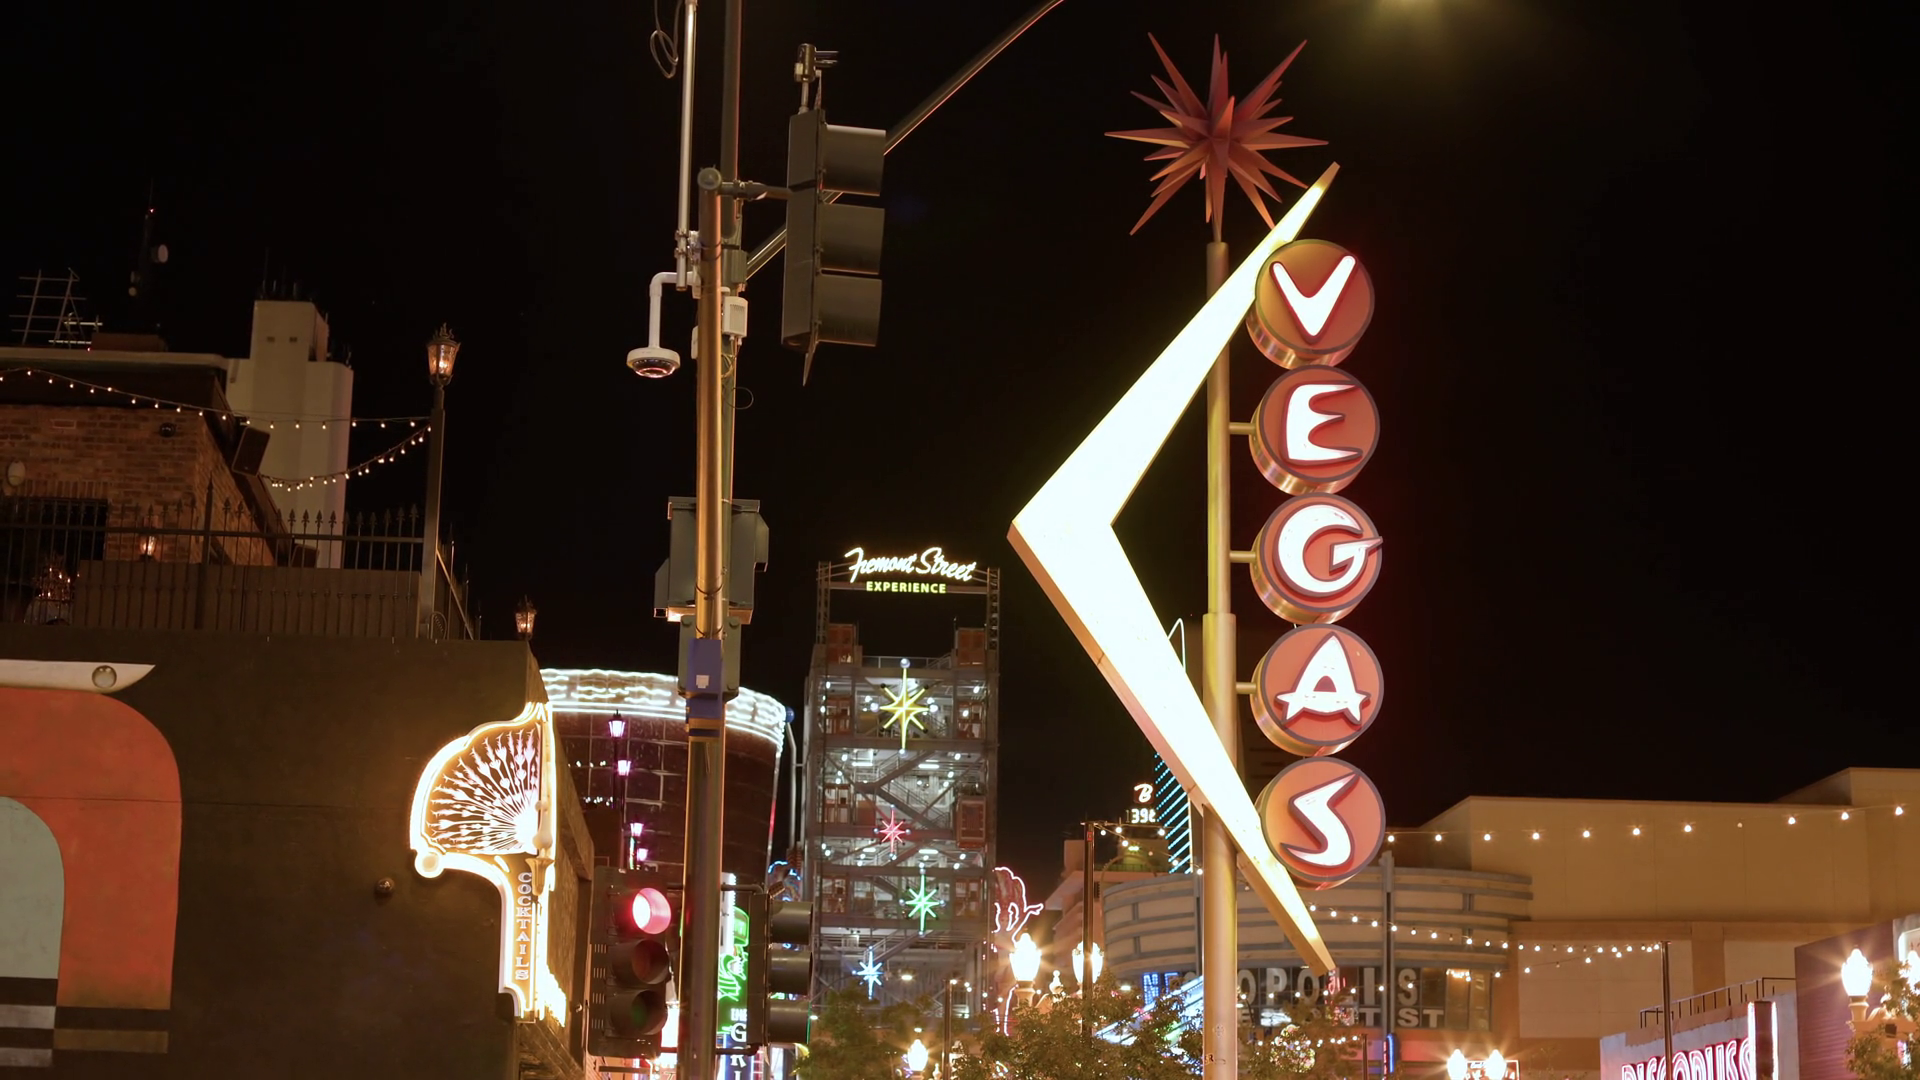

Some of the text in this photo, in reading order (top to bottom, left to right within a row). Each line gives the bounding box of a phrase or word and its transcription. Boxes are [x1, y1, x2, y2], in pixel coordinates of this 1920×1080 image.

[844, 546, 977, 584] Fremont Street
[1270, 254, 1384, 868] VEGAS
[865, 581, 947, 594] EXPERIENCE
[1133, 783, 1154, 803] B
[515, 872, 533, 981] COCKTAILS
